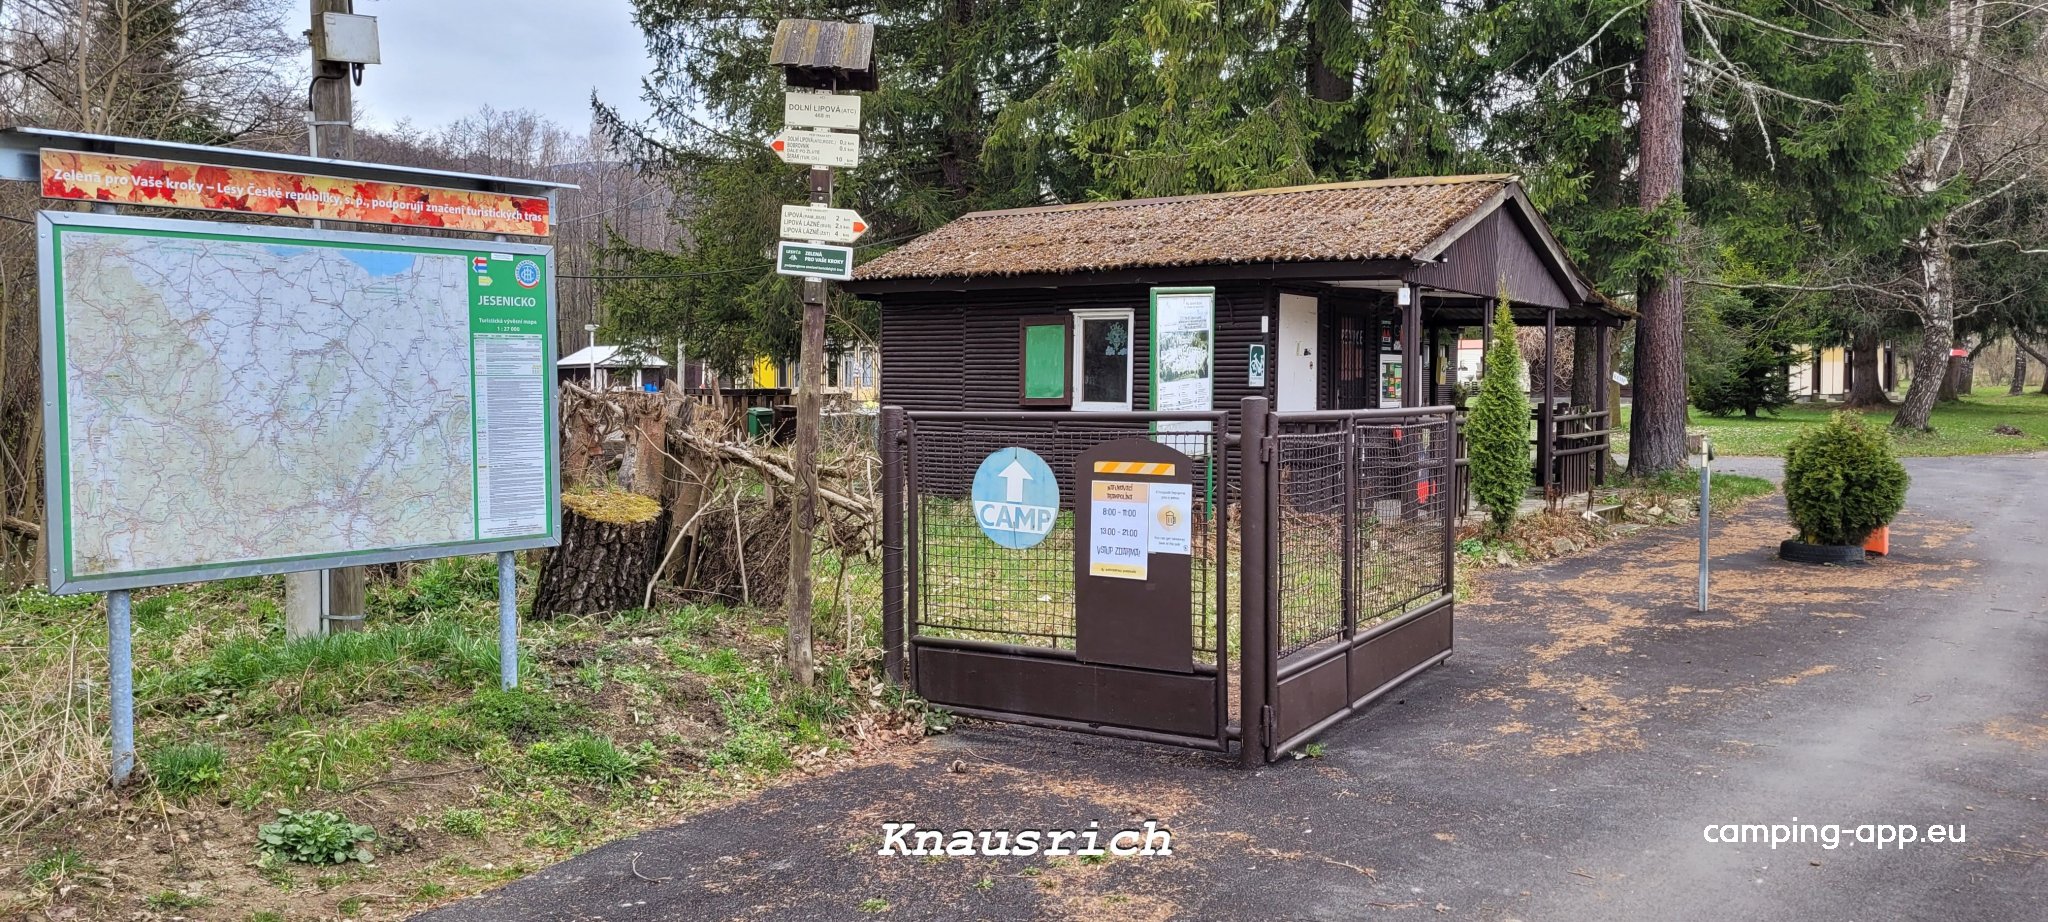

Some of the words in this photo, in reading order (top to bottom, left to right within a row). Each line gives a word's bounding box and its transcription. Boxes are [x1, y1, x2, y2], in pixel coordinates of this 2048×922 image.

[54, 169, 100, 182] Zelená
[106, 174, 128, 186] pro
[131, 175, 163, 188] Vaše
[166, 176, 203, 193] kroky
[217, 182, 243, 198] Lesy
[247, 183, 282, 198] České
[286, 190, 342, 205] republiky,
[372, 199, 423, 213] podporují
[426, 204, 464, 215] značení
[467, 206, 522, 220] turistických
[525, 212, 542, 222] tras
[478, 295, 536, 307] JESENICKO
[980, 504, 1051, 531] CAMP
[1103, 508, 1116, 516] 8:00
[1096, 545, 1113, 555] VSTUP
